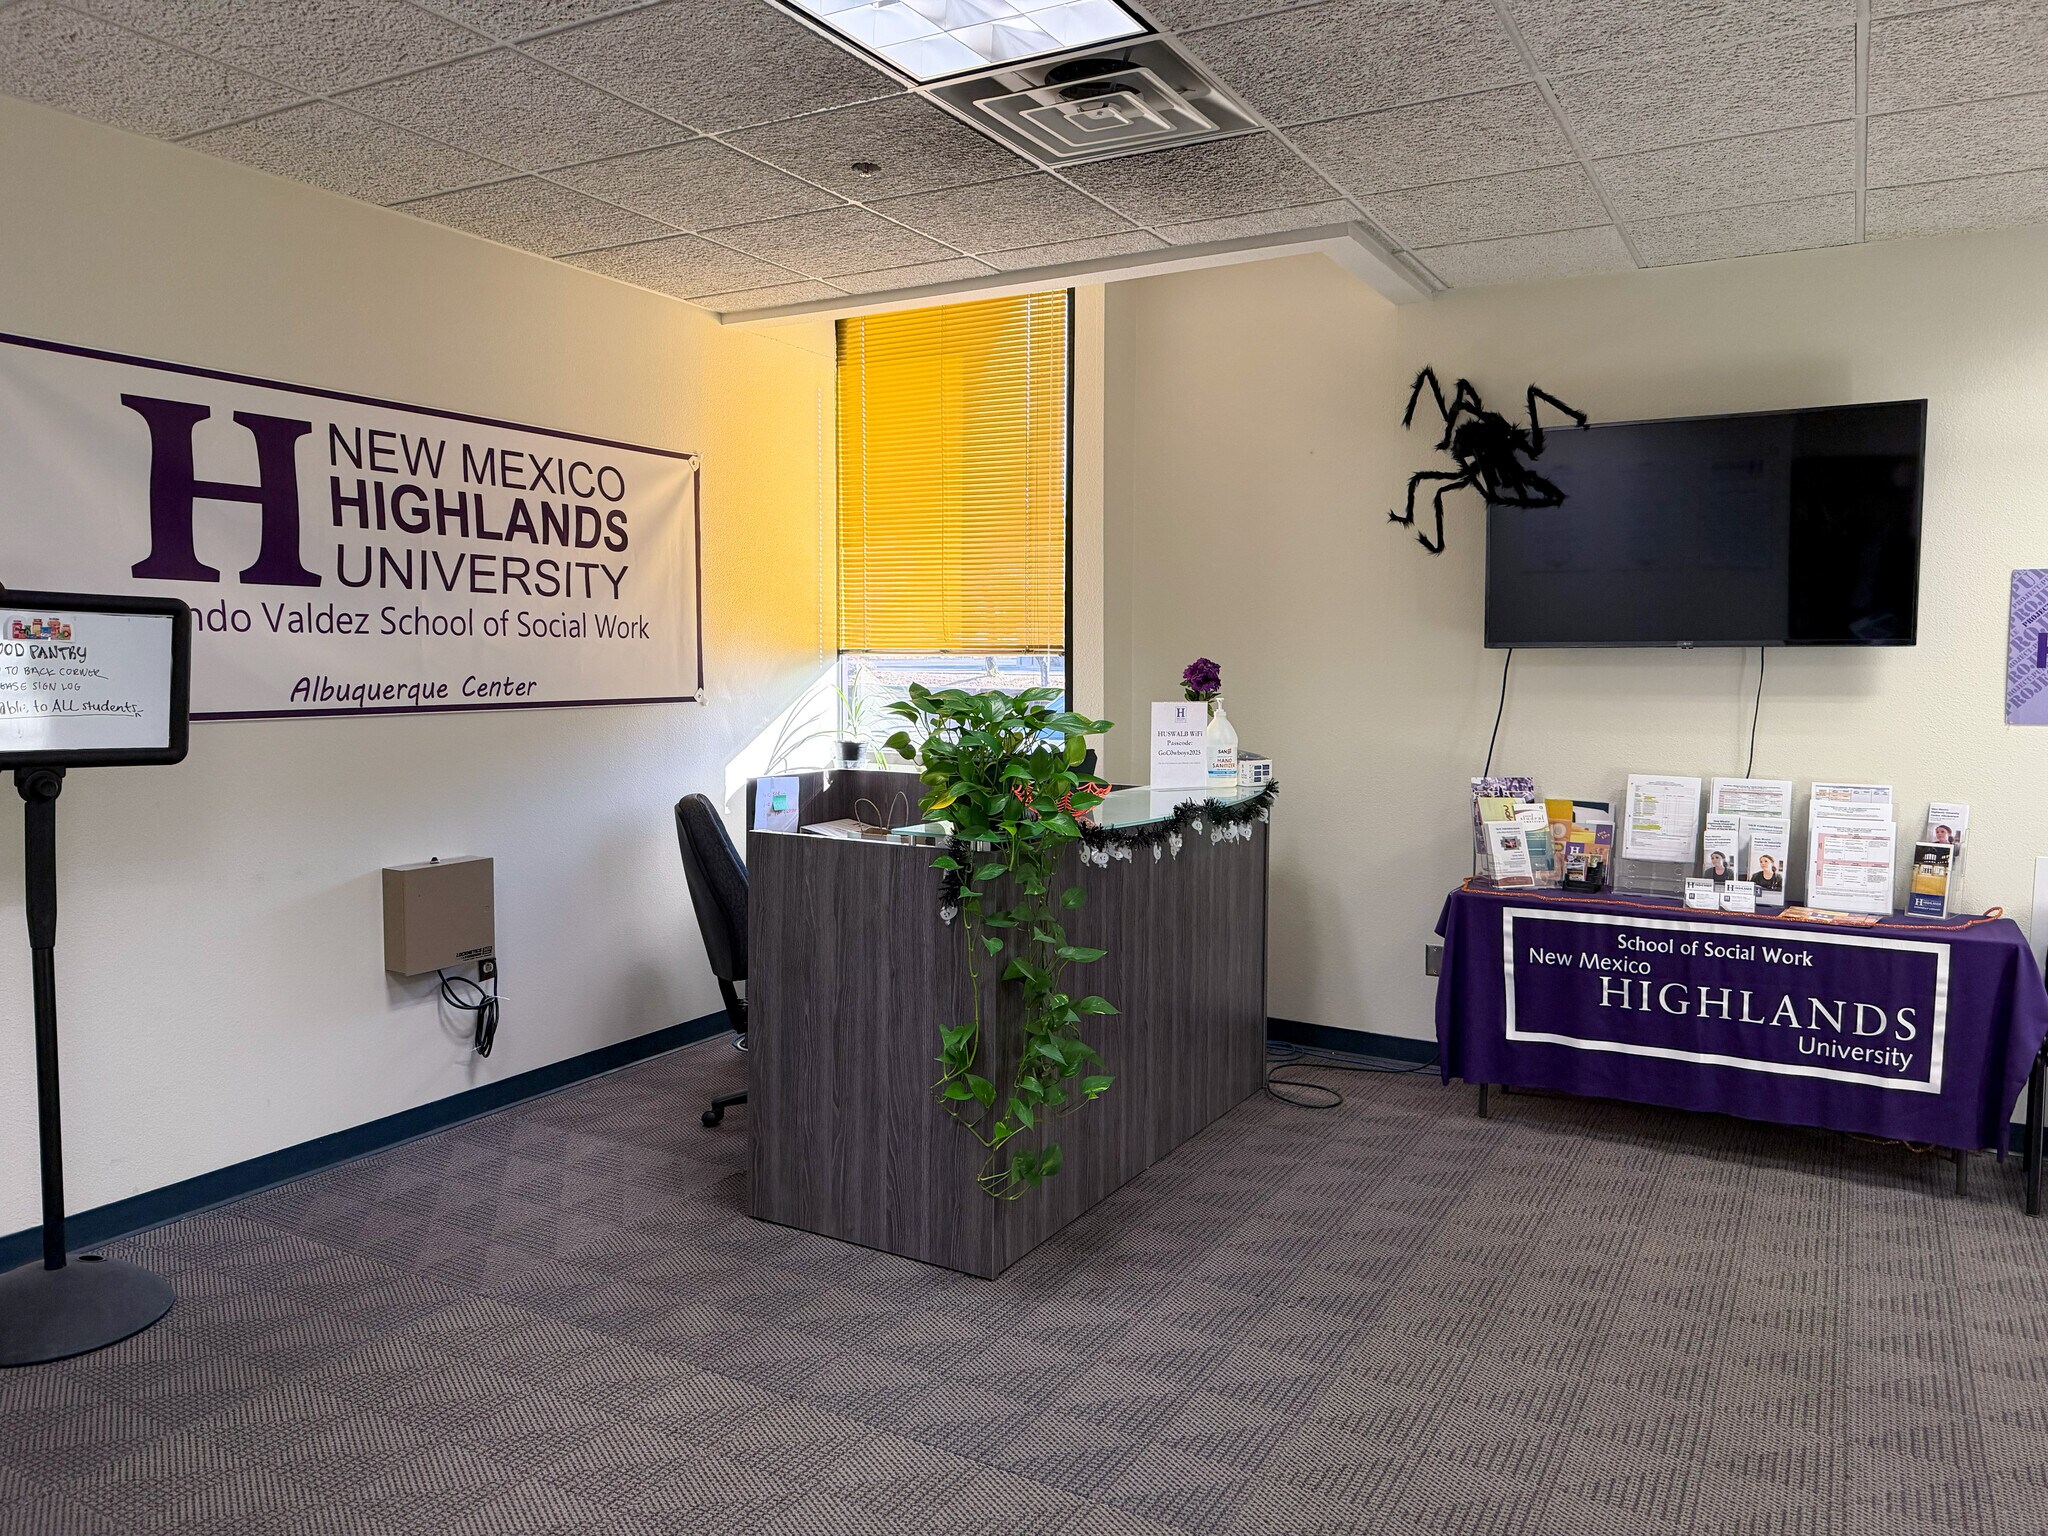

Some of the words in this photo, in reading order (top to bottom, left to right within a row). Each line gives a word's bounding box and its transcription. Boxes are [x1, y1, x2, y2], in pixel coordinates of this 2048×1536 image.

[328, 422, 447, 480] NEW
[462, 443, 626, 503] MEXICO
[119, 392, 323, 588] H
[329, 475, 630, 554] HIGHLANDS
[336, 543, 630, 600] UNIVERSITY
[260, 602, 371, 637] Valdez
[380, 605, 474, 638] School
[483, 606, 511, 638] of
[517, 609, 588, 640] Social
[594, 613, 651, 640] Work
[29, 644, 87, 664] PANTRY
[4, 665, 19, 676] TO
[24, 666, 57, 677] BACK
[59, 668, 109, 680] CORNER
[32, 681, 57, 691] SIGN
[61, 682, 82, 692] LOG
[33, 699, 48, 713] to
[51, 698, 79, 713] ALL
[290, 676, 449, 708] Albuquerque
[462, 675, 537, 700] Center
[1177, 708, 1185, 717] H
[1529, 947, 1573, 966] New
[1579, 952, 1652, 975] Mexico
[1617, 933, 1674, 955] School
[1680, 938, 1700, 956] of
[1704, 942, 1755, 961] Social
[1761, 946, 1814, 967] Work
[1599, 976, 1917, 1041] HIGHLANDS
[1798, 1036, 1914, 1073] University
